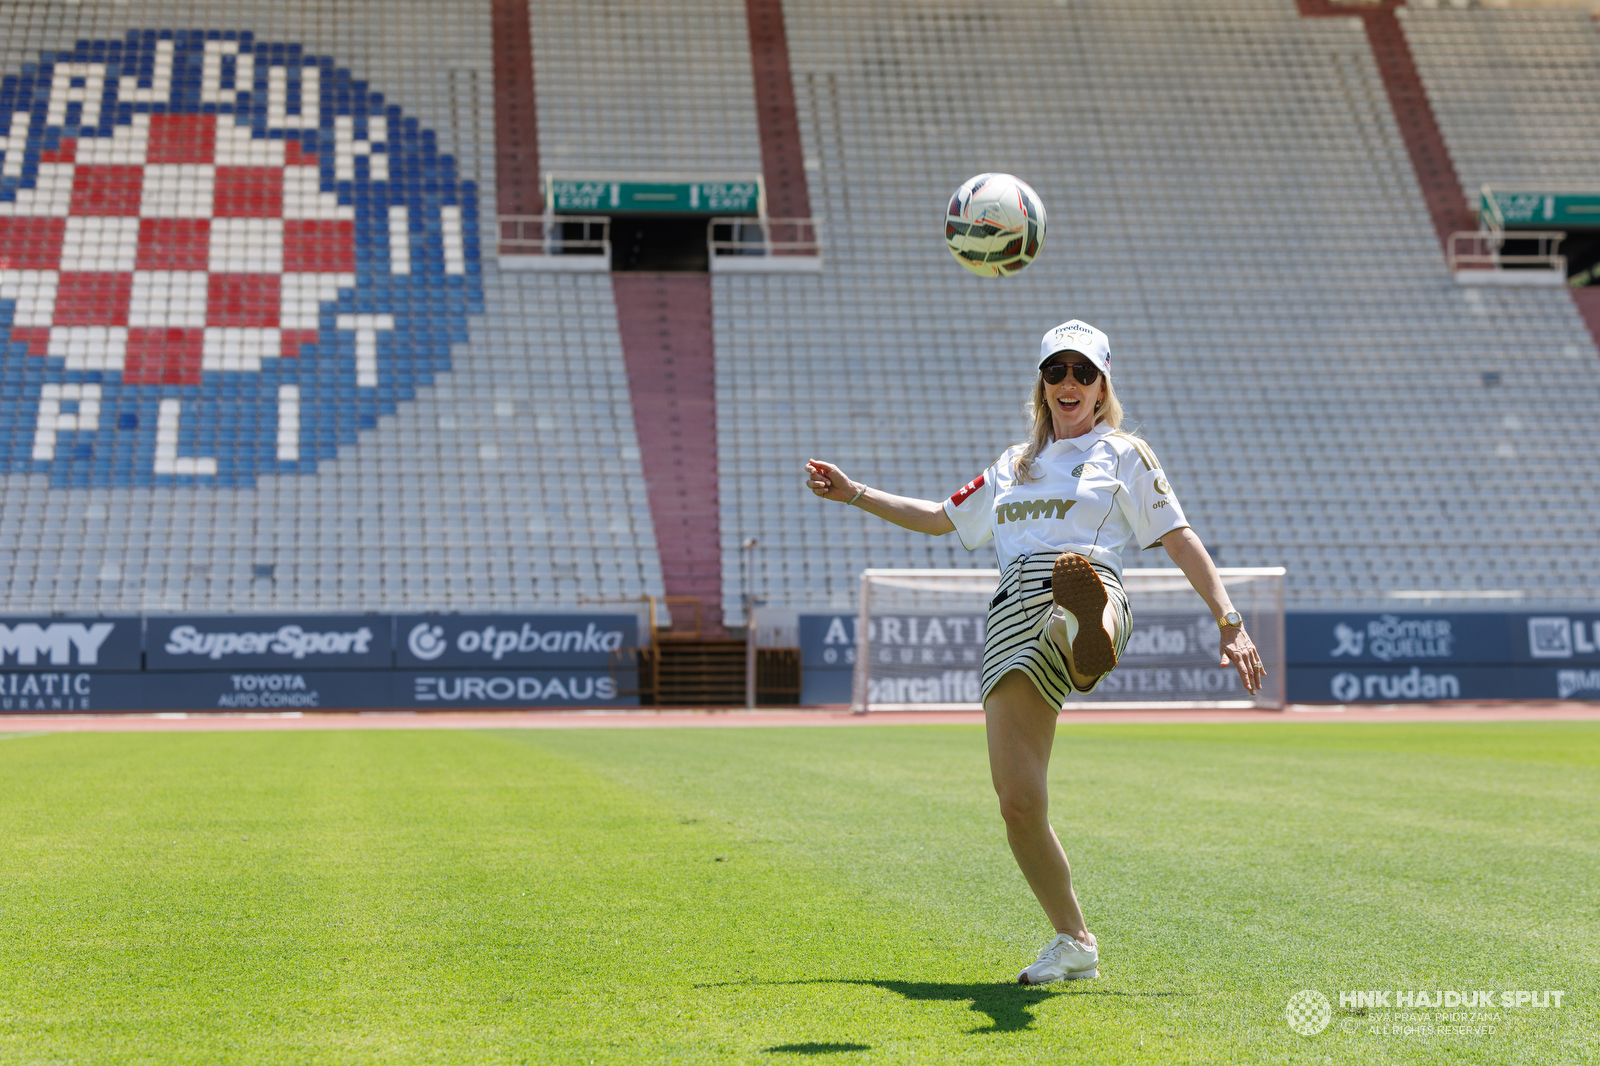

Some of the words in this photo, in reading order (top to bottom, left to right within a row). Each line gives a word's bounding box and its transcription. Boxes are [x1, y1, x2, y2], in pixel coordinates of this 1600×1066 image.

[1054, 332, 1092, 348] 250
[1055, 324, 1093, 334] Freedom
[996, 499, 1077, 524] TOMMY
[165, 624, 373, 659] SuperSport
[457, 622, 624, 660] otpbanka
[1369, 638, 1453, 661] QUELLE
[230, 673, 307, 691] TOYOTA
[414, 677, 618, 700] EURODAUS
[1363, 666, 1460, 699] rudan
[217, 692, 259, 707] AUTO
